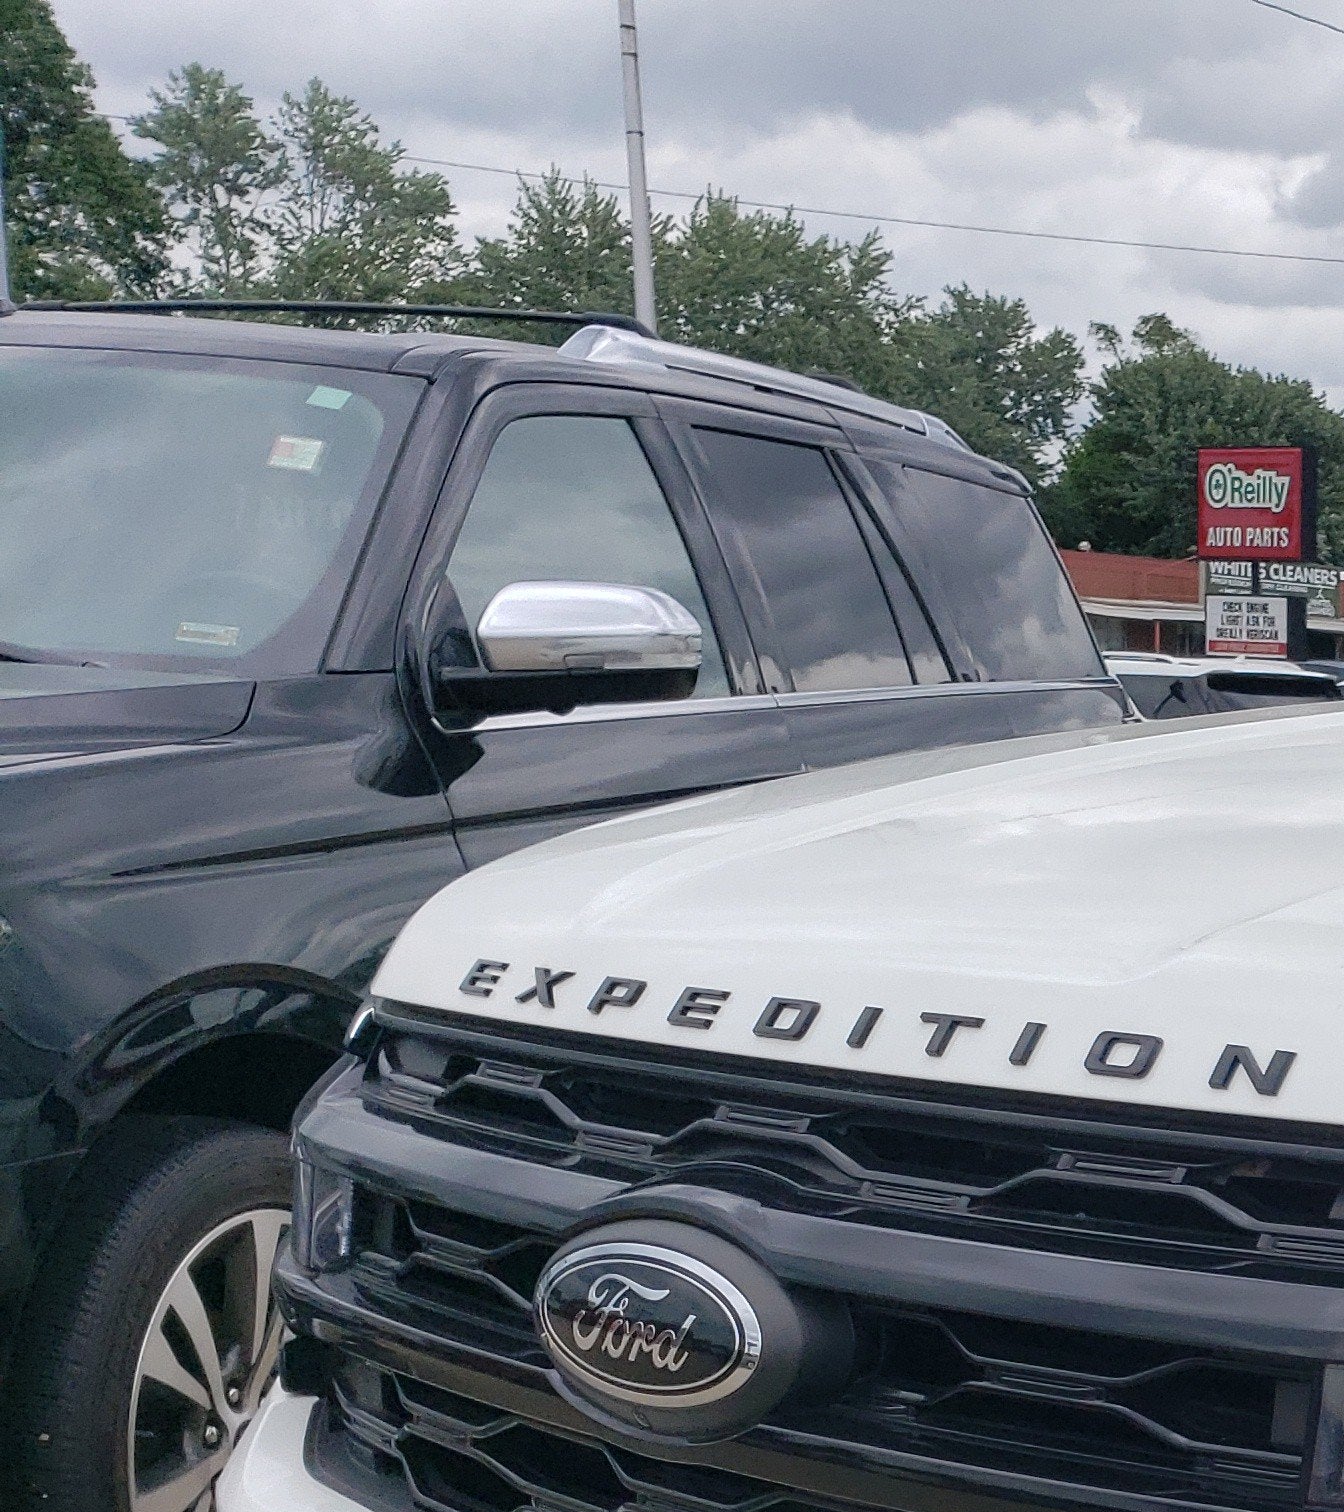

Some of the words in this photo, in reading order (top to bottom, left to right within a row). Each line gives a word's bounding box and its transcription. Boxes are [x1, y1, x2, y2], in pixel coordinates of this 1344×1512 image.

[1208, 465, 1286, 507] O'Reilly
[1206, 527, 1241, 547] AUTO
[1246, 527, 1288, 547] PARTS
[1269, 563, 1338, 586] CLEANERS
[459, 957, 1299, 1097] EXPEDITION
[572, 1273, 697, 1372] Ford
